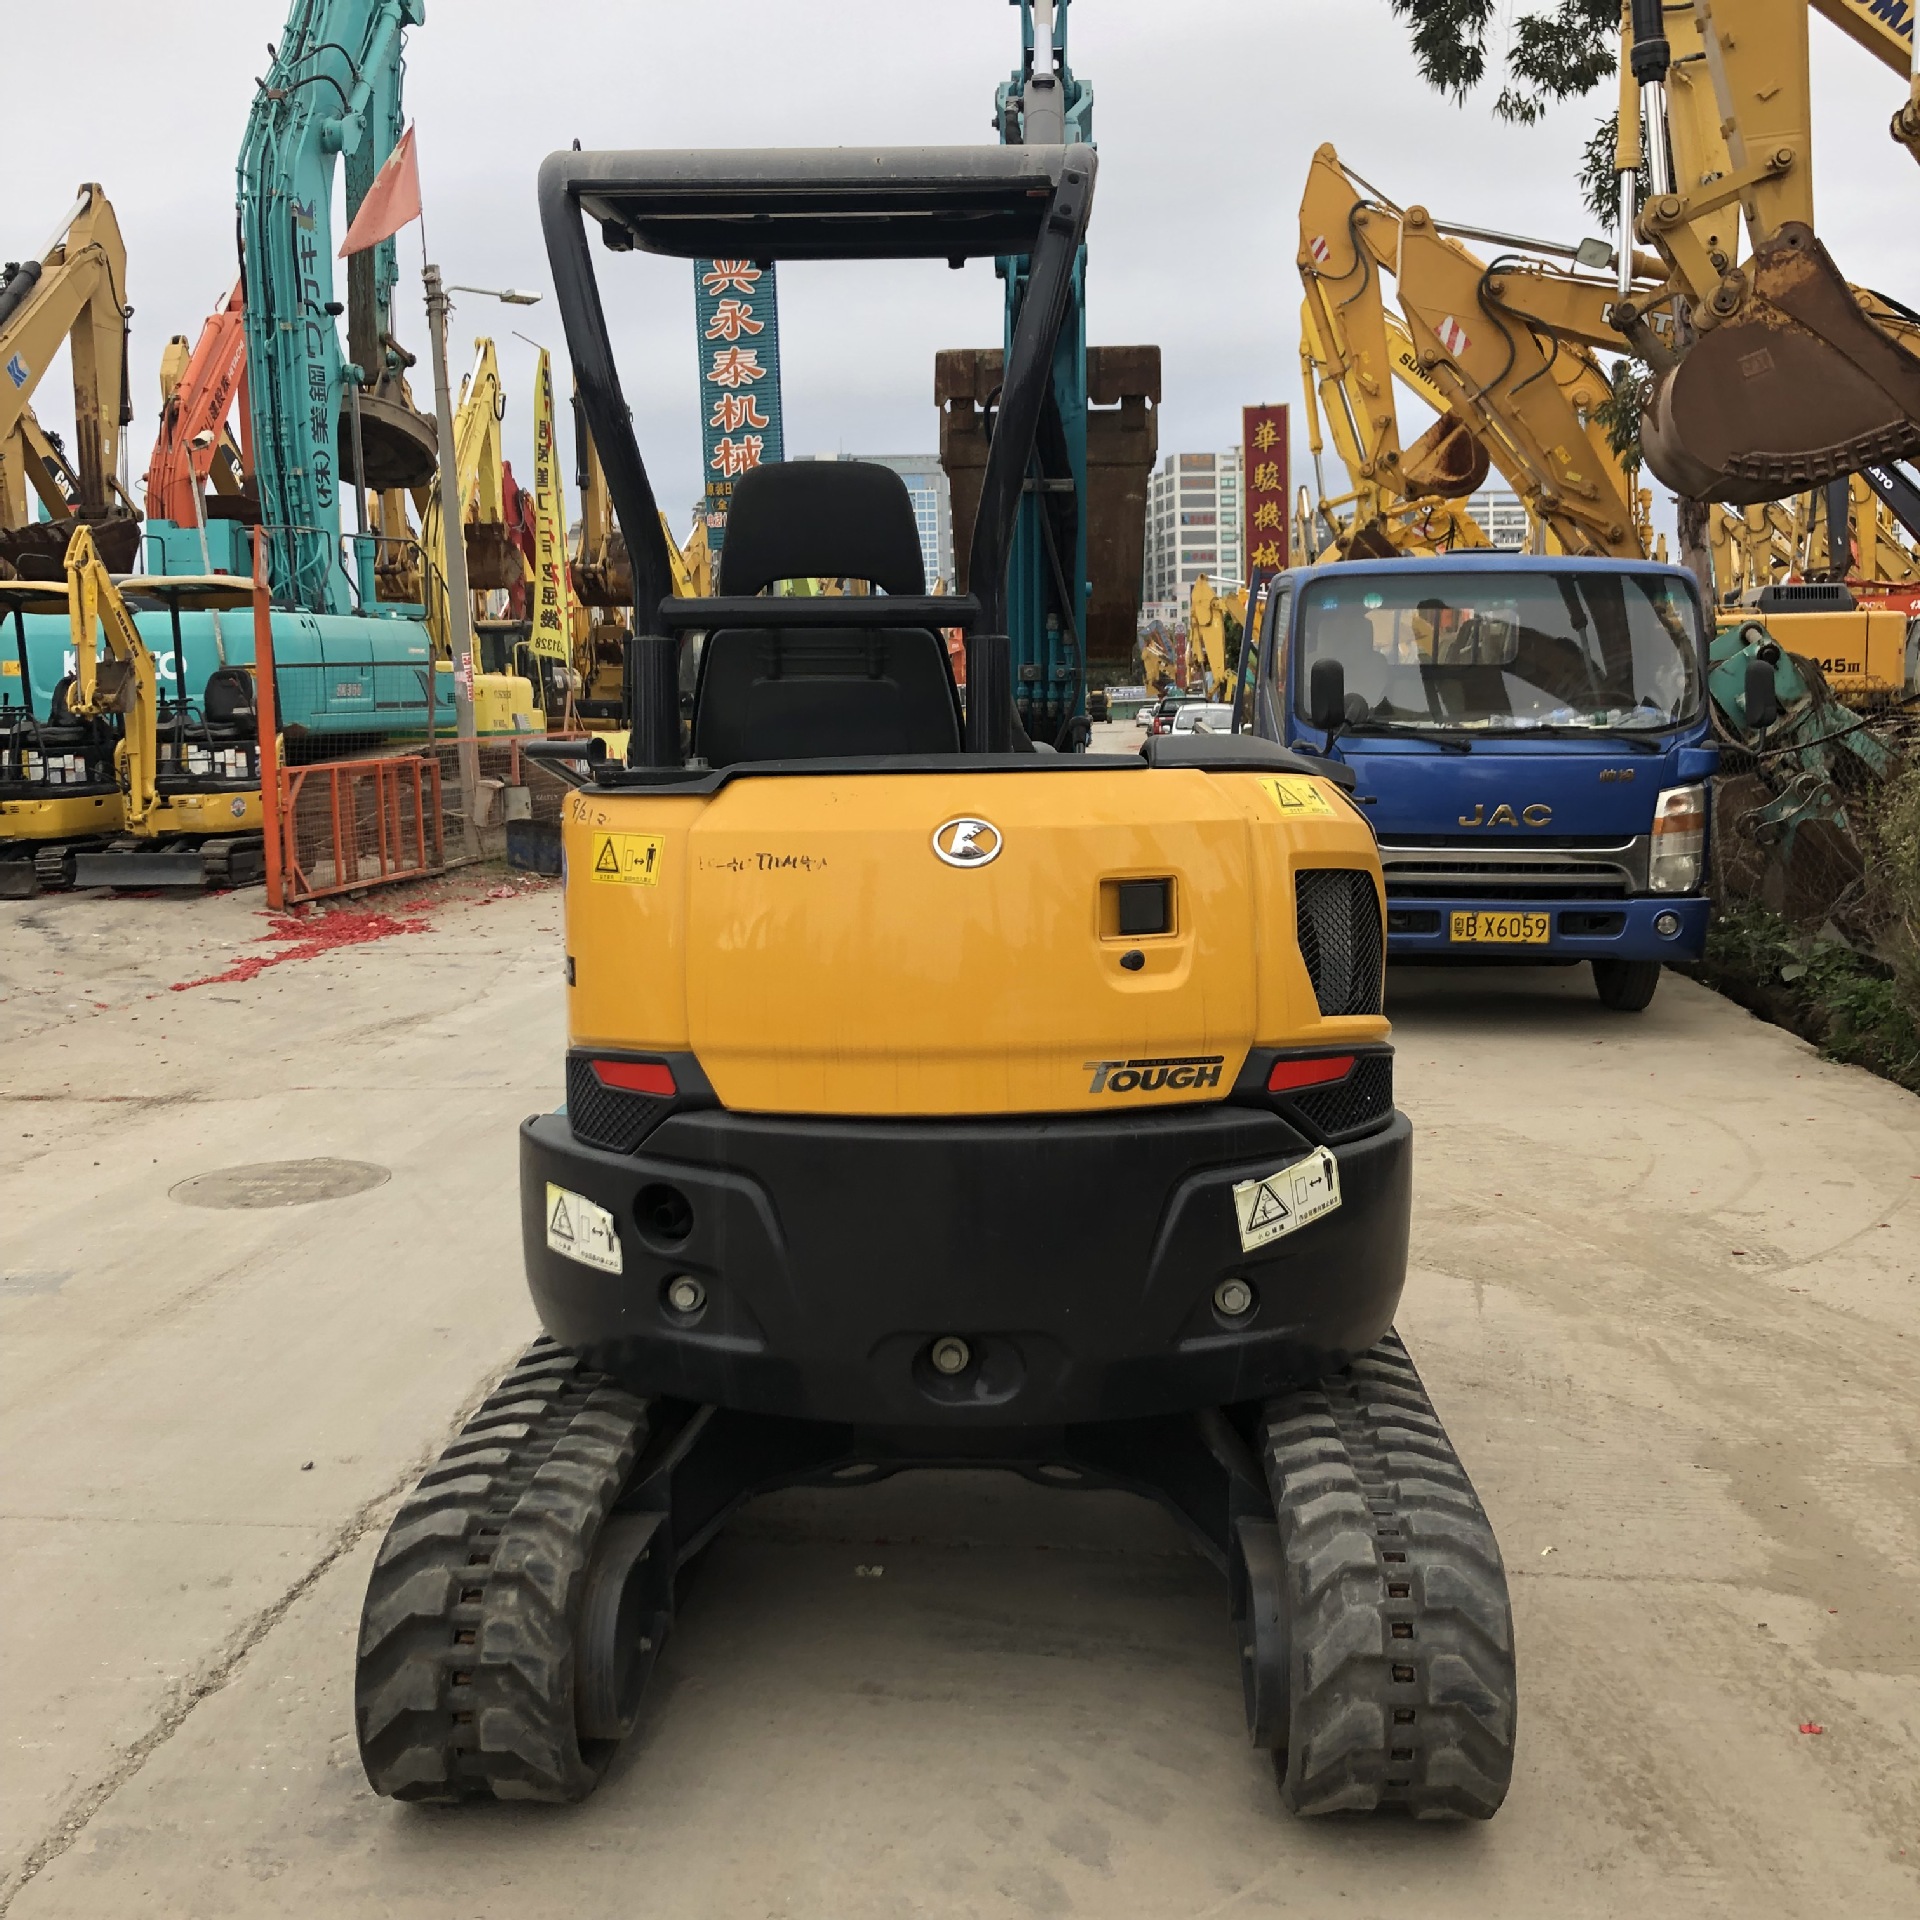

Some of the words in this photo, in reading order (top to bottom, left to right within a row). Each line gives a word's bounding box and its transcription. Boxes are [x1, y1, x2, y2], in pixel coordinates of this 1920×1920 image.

[1867, 465, 1894, 490] ATO
[1250, 418, 1286, 573] 華駿機械
[1457, 803, 1552, 827] JAC
[1083, 1060, 1223, 1093] TOUGH
